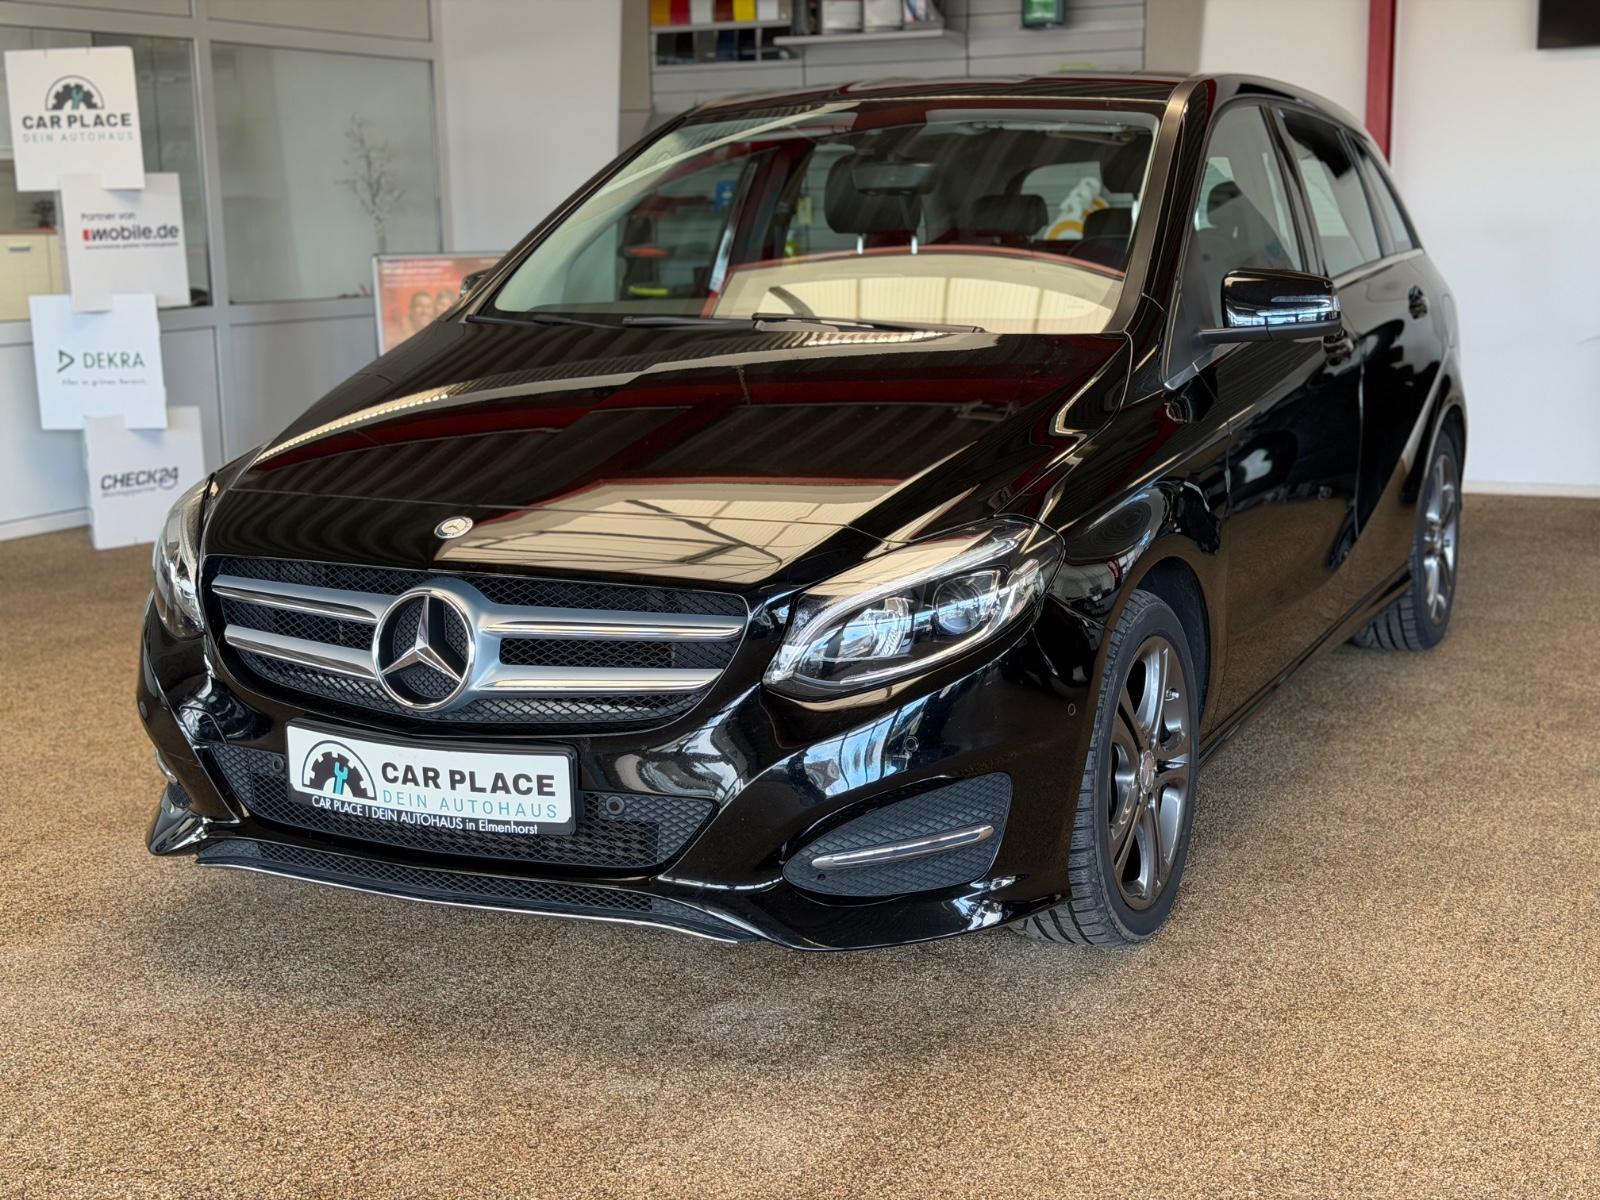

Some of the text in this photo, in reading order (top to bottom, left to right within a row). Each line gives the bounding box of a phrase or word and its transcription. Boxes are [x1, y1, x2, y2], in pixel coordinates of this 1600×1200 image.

[22, 113, 132, 129] CAR PLACE
[23, 131, 133, 143] DEIN AUTOHAUS
[92, 224, 179, 241] mobile.de
[83, 352, 145, 369] DEKRA
[101, 466, 178, 490] CHECK24
[381, 762, 556, 797] CAR PLACE
[383, 790, 557, 818] DEIN AUTOHAUS
[312, 796, 331, 810] CAR
[333, 800, 363, 816] PLACE
[371, 807, 397, 821] DEIN
[400, 812, 463, 830] AUTOHAUS
[465, 820, 476, 831] in
[479, 819, 538, 834] Elmenhorst
